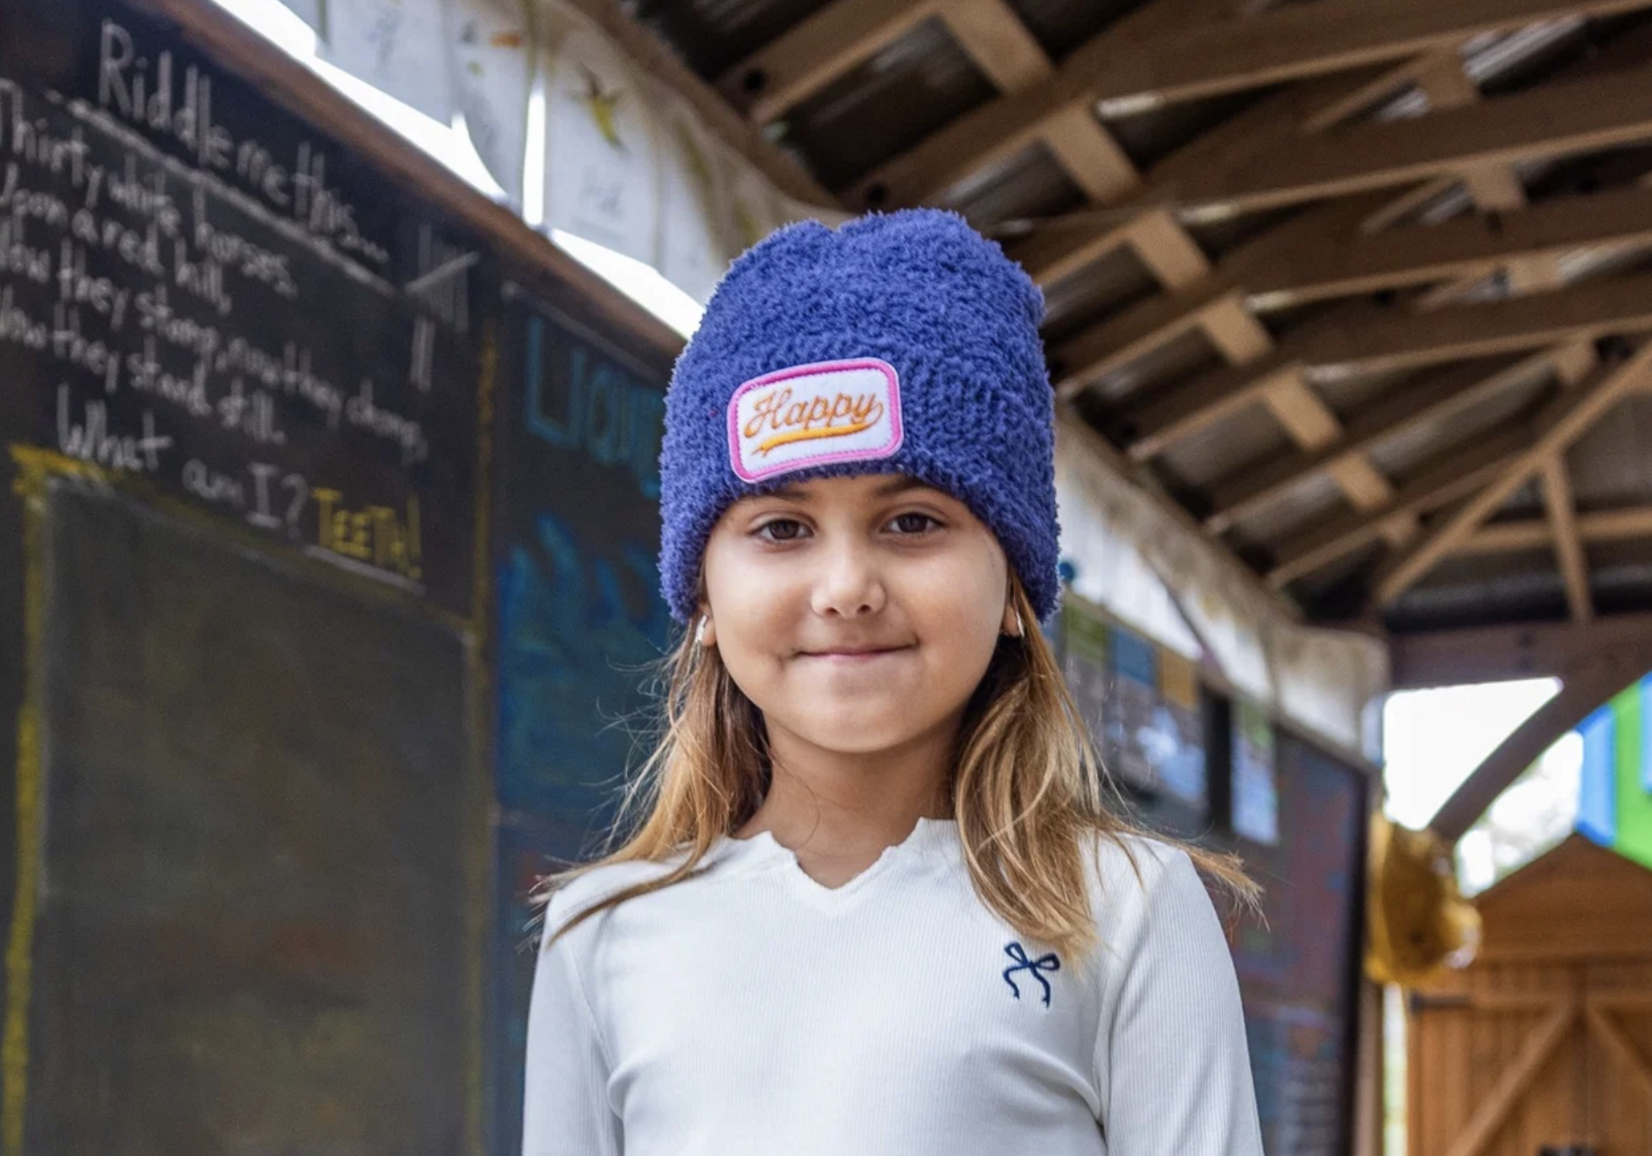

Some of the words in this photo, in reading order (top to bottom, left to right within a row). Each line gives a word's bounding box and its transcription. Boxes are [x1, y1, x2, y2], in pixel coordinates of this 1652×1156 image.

[100, 18, 234, 167] Riddle
[56, 236, 130, 330] they
[57, 382, 174, 473] What
[744, 386, 885, 439] Happy
